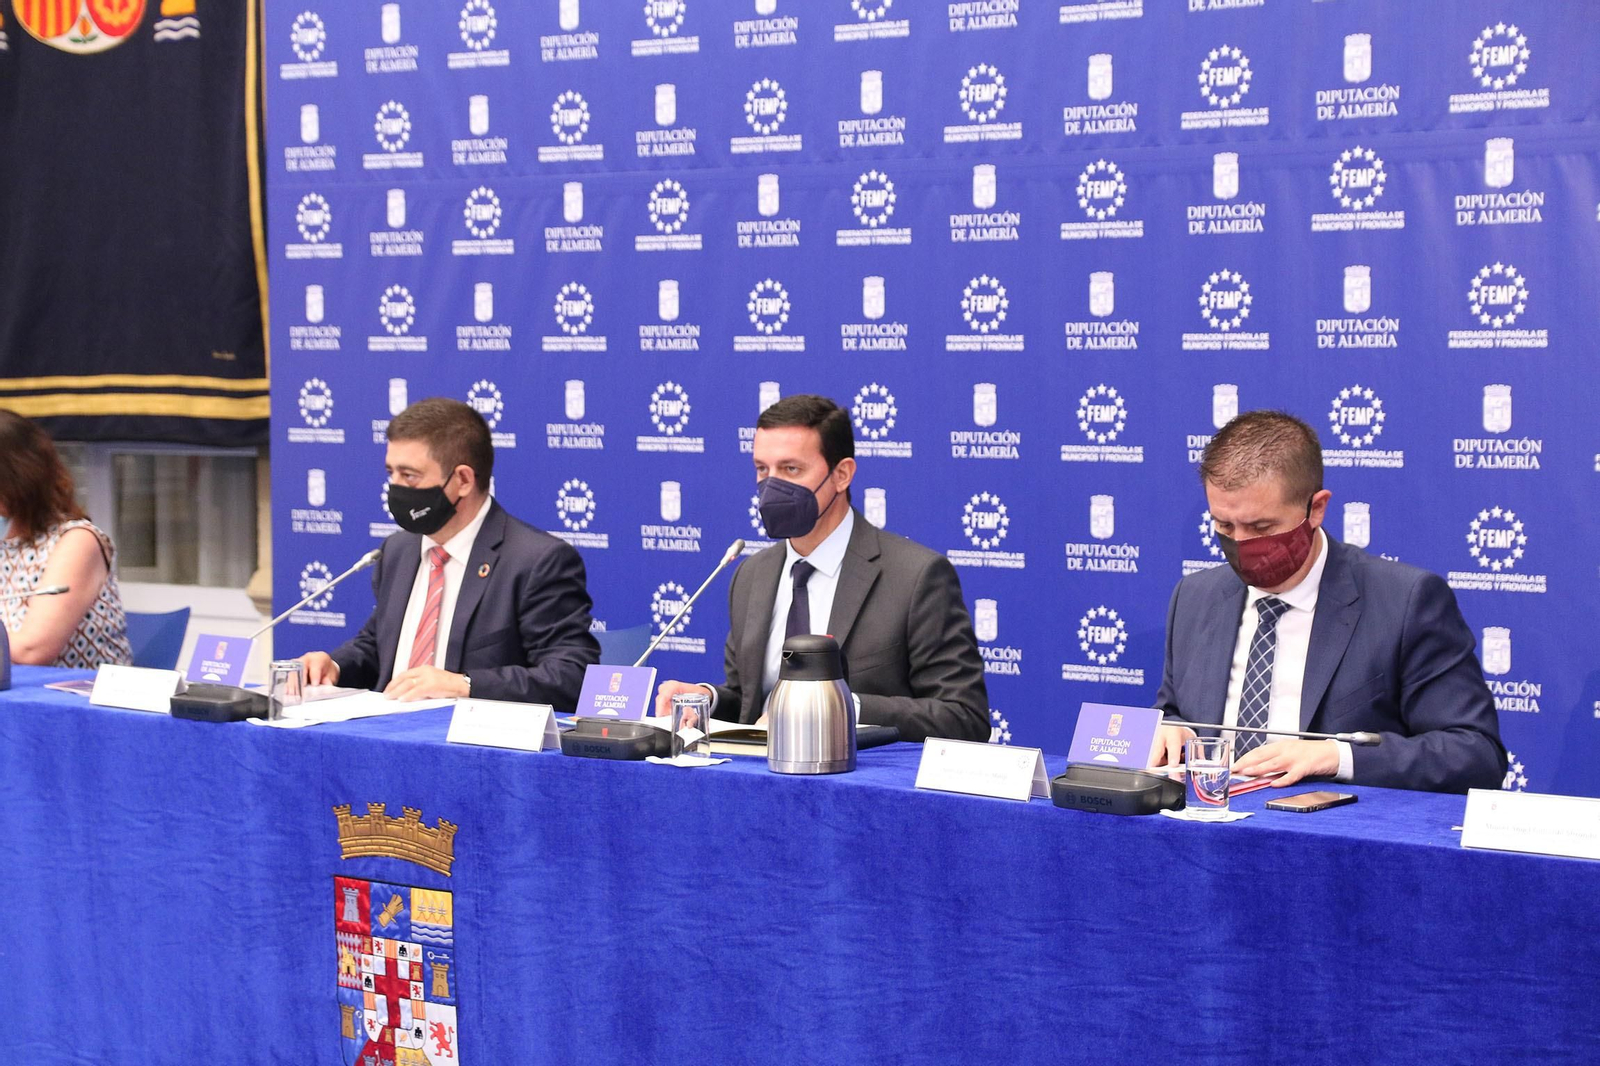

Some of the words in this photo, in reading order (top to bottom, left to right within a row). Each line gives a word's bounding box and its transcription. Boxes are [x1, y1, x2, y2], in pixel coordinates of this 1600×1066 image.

[653, 0, 677, 18] FEMP
[948, 0, 1019, 17] DIPUTACIÓN
[734, 17, 798, 34] DIPUTACIÓN
[950, 18, 966, 32] DE
[966, 13, 1018, 31] ALMERÍA
[735, 34, 750, 48] DE
[750, 31, 797, 47] ALMERÍA
[1482, 45, 1518, 67] FEMP
[1210, 67, 1241, 87] FEMP
[969, 84, 997, 103] FEMP
[1316, 84, 1400, 105] DIPUTACIÓN
[1538, 88, 1549, 98] DE
[753, 98, 779, 116] FEMP
[1064, 102, 1138, 120] DIPUTACIÓN
[1317, 106, 1336, 120] DE
[1338, 101, 1398, 119] ALMERÍA
[838, 117, 906, 134] DIPUTACIÓN
[1064, 121, 1081, 136] DE
[1082, 118, 1136, 134] ALMERÍA
[636, 128, 696, 144] DIPUTACIÓN
[840, 134, 855, 148] DE
[856, 131, 904, 147] ALMERÍA
[637, 144, 651, 157] DE
[651, 142, 695, 156] ALMERÍA
[1341, 168, 1375, 188] FEMP
[861, 190, 887, 208] FEMP
[1087, 181, 1116, 200] FEMP
[657, 198, 681, 215] FEMP
[1455, 190, 1544, 209] DIPUTACIÓN
[1187, 202, 1265, 220] DIPUTACIÓN
[1394, 211, 1404, 219] DE
[1456, 211, 1475, 226] DE
[1478, 208, 1542, 224] ALMERÍA
[736, 219, 800, 234] DIPUTACIÓN
[950, 212, 1020, 228] DIPUTACIÓN
[1188, 221, 1206, 235] DE
[1207, 218, 1264, 234] ALMERÍA
[738, 235, 753, 248] DE
[753, 233, 799, 247] ALMERÍA
[951, 228, 967, 242] DE
[968, 227, 1019, 242] ALMERÍA
[1211, 290, 1242, 309] FEMP
[1480, 284, 1516, 305] FEMP
[756, 298, 782, 315] FEMP
[971, 295, 999, 313] FEMP
[639, 324, 700, 338] DIPUTACIÓN
[841, 323, 908, 337] DIPUTACIÓN
[1065, 320, 1139, 336] DIPUTACIÓN
[1316, 317, 1400, 333] DIPUTACIÓN
[1537, 329, 1548, 338] DE
[640, 338, 654, 351] DE
[654, 338, 699, 351] ALMERÍA
[842, 338, 858, 351] DE
[858, 338, 907, 351] ALMERÍA
[1066, 337, 1083, 350] DE
[1084, 336, 1138, 350] ALMERÍA
[1317, 334, 1336, 348] DE
[1337, 333, 1398, 348] ALMERÍA
[658, 400, 682, 417] FEMP
[861, 402, 888, 420] FEMP
[1087, 404, 1117, 423] FEMP
[1340, 406, 1374, 426] FEMP
[950, 430, 1020, 445] DIPUTACIÓN
[1452, 437, 1542, 454] DIPUTACIÓN
[952, 445, 968, 458] DE
[968, 446, 1020, 459] ALMERÍA
[1454, 454, 1474, 468] DE
[1476, 454, 1540, 470] ALMERÍA
[972, 512, 1000, 530] FEMP
[640, 526, 702, 539] DIPUTACIÓN
[1479, 528, 1514, 549] FEMP
[642, 538, 656, 550] DE
[656, 538, 700, 552] ALMERÍA
[1065, 544, 1140, 559] DIPUTACIÓN
[1066, 557, 1084, 570] DE
[1085, 558, 1138, 573] ALMERÍA
[1535, 575, 1547, 583] DE
[1088, 626, 1117, 645] FEMP
[978, 646, 1022, 661] TACIÓN
[984, 661, 1020, 675] MERÍA
[1485, 680, 1541, 697] TACIÓN
[1494, 696, 1540, 713] MERÍA
[584, 745, 611, 754] BOSCH
[1091, 737, 1131, 748] DIPUTACIÓN
[1099, 745, 1128, 754] ALMERÍA
[1080, 795, 1112, 806] BOSCH
